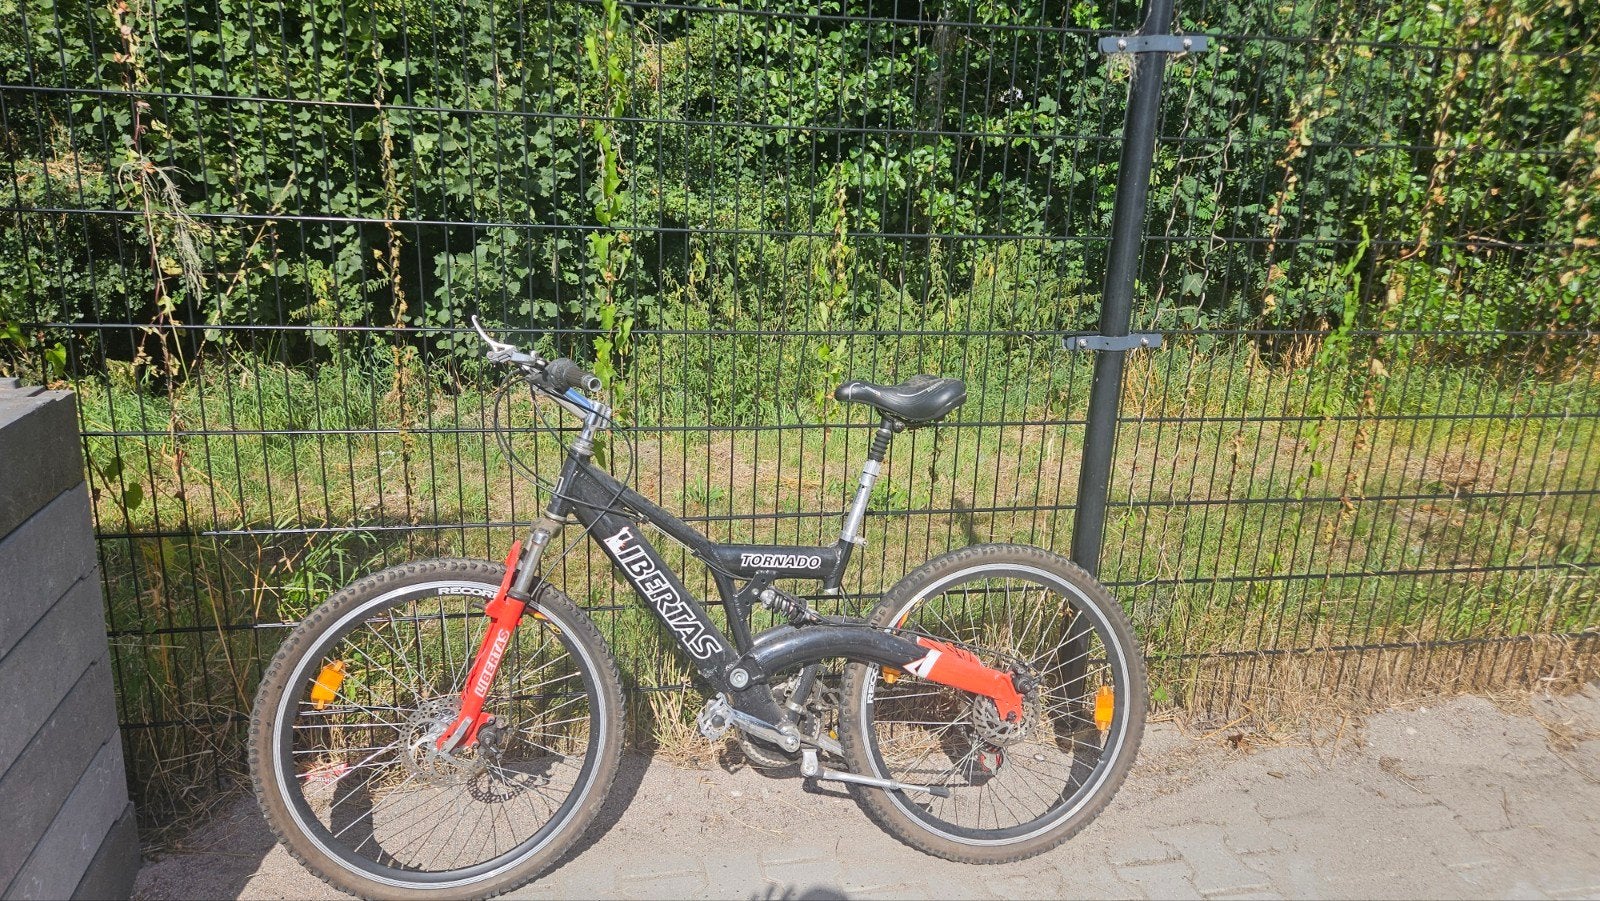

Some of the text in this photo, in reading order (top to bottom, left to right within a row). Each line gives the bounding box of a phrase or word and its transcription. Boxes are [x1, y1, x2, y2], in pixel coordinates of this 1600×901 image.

[741, 553, 821, 570] TORNADO
[438, 586, 500, 600] RECOR
[604, 526, 722, 659] LIBERTAS
[474, 628, 511, 698] LIBERTAS
